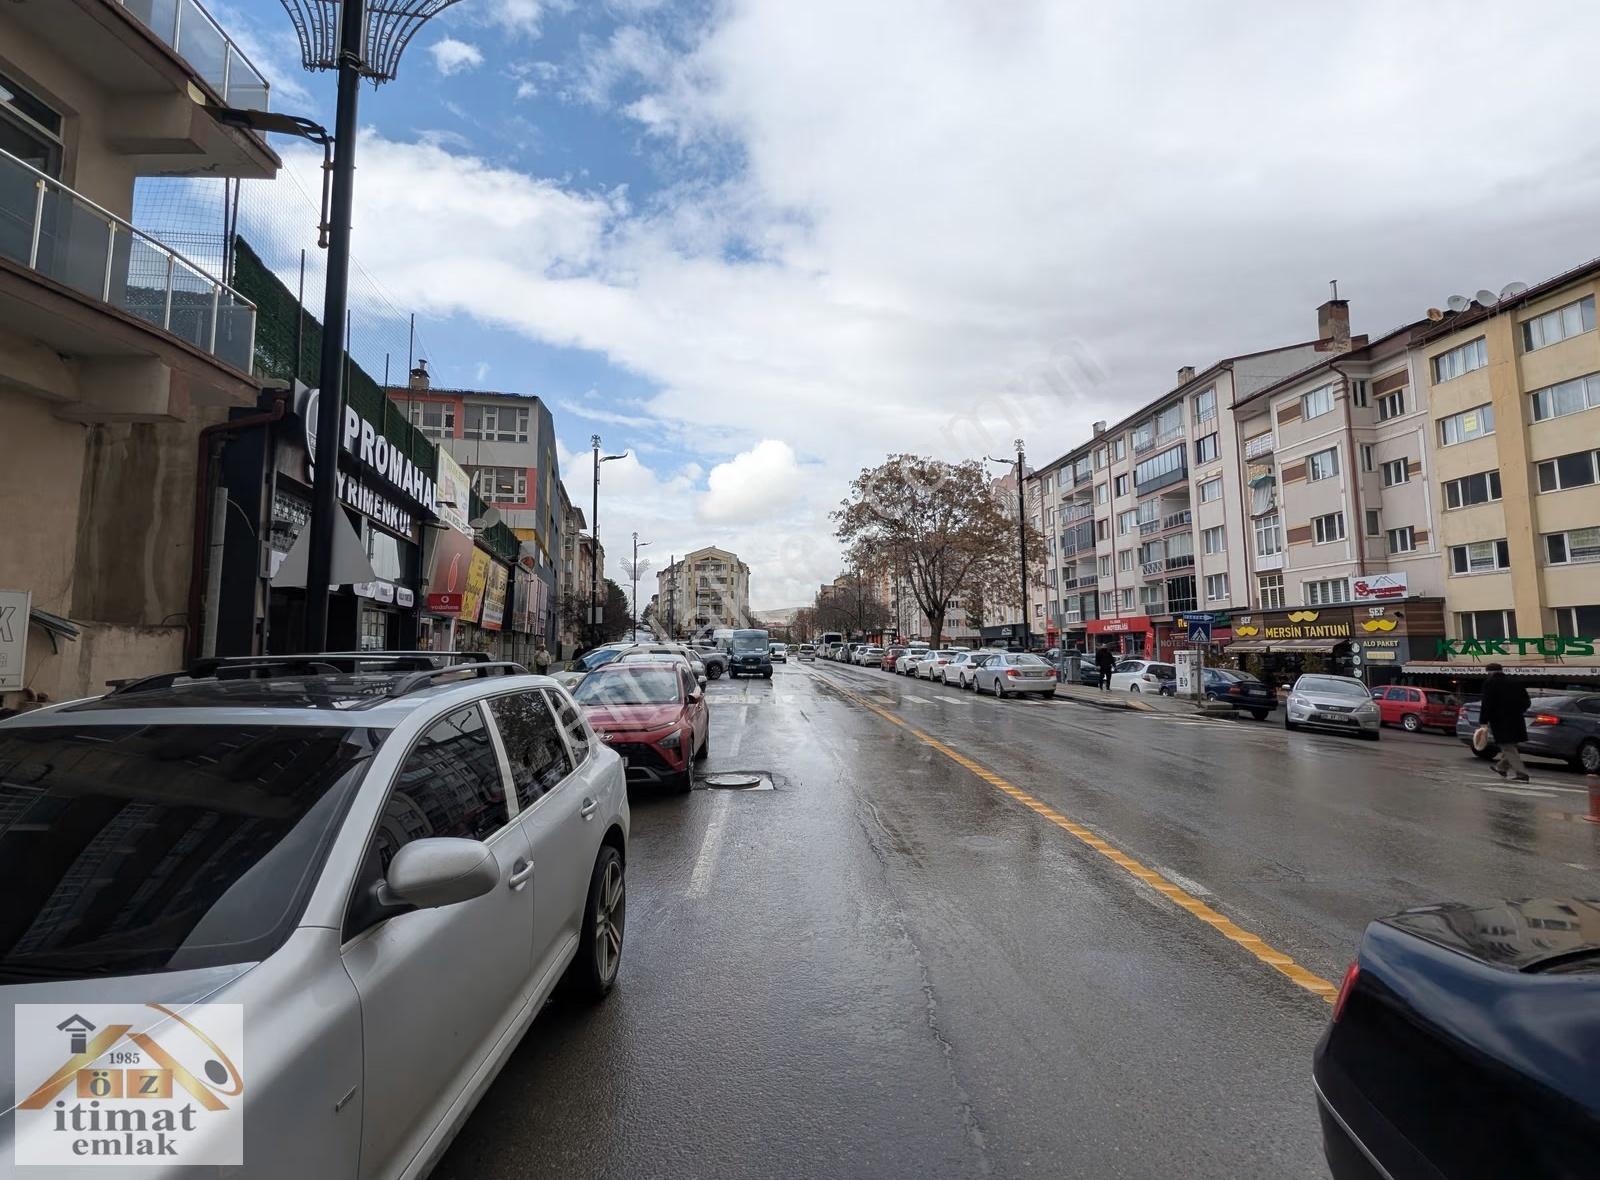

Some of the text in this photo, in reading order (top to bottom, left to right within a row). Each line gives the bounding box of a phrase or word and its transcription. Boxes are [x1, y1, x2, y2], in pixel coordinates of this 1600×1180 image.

[1368, 607, 1385, 618] ŞEF
[1240, 616, 1252, 626] ŞEF
[1265, 622, 1350, 640] MERSİN TANTUNİ
[1363, 639, 1399, 648] ALO PAKET
[1436, 634, 1595, 657] KAKTÜS
